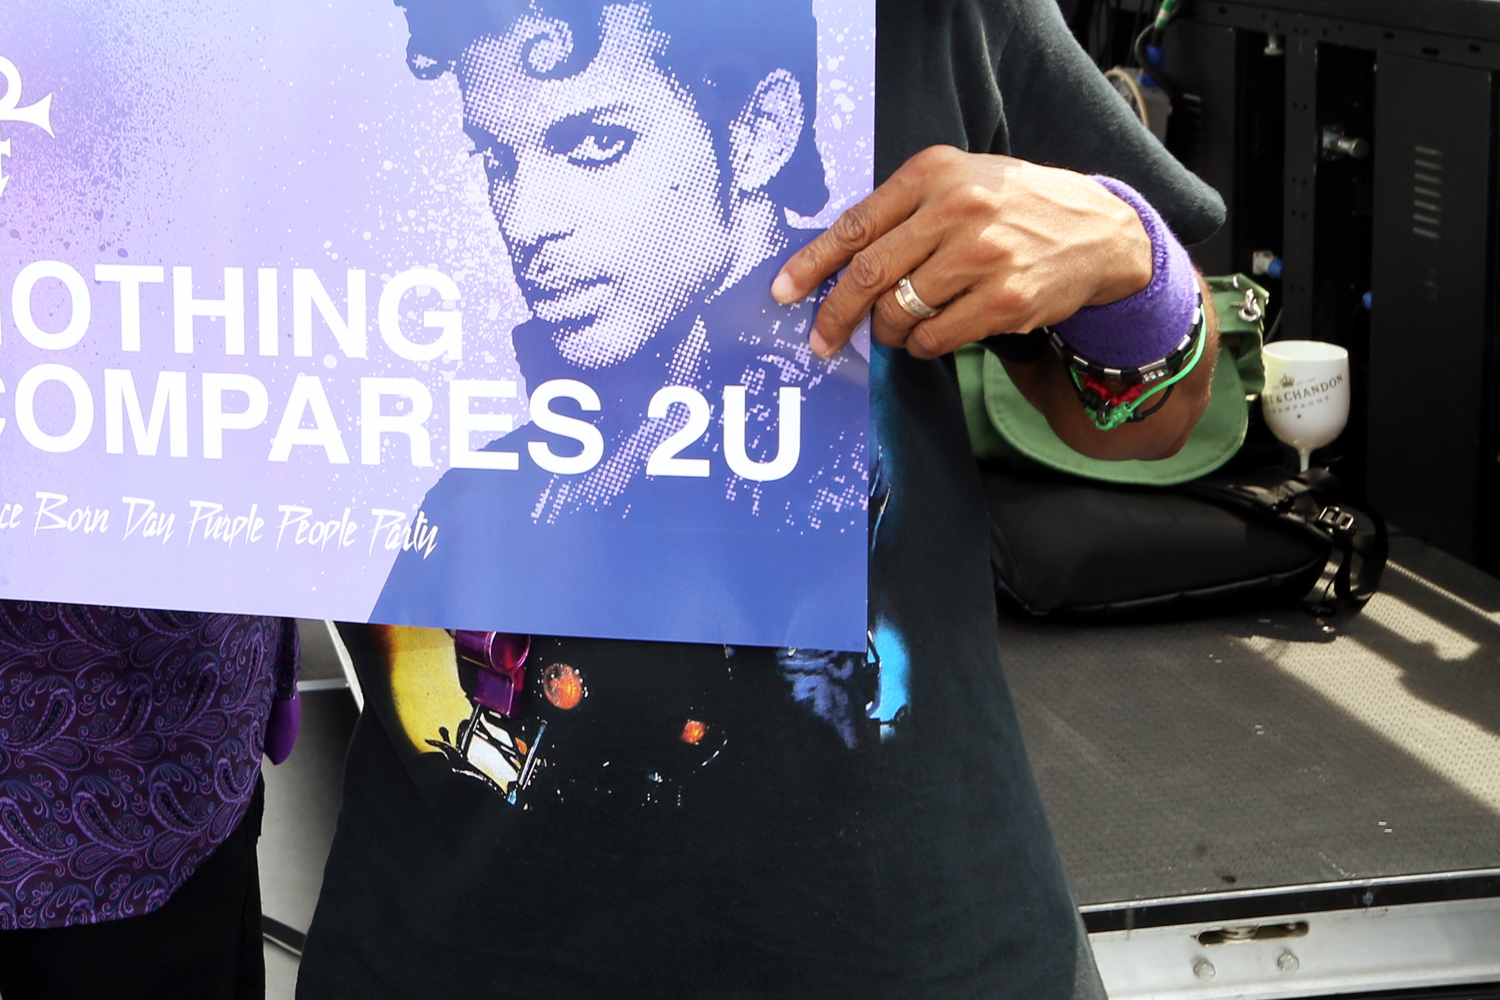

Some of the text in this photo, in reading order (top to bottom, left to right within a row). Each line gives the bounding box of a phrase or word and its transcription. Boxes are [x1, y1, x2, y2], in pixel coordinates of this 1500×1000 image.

[1283, 373, 1343, 403] CHANDON
[646, 385, 802, 482] 2U
[32, 491, 110, 537] Born
[120, 496, 176, 546] Day
[187, 500, 266, 550] Purple
[274, 504, 358, 554] People
[367, 508, 440, 560] Party
